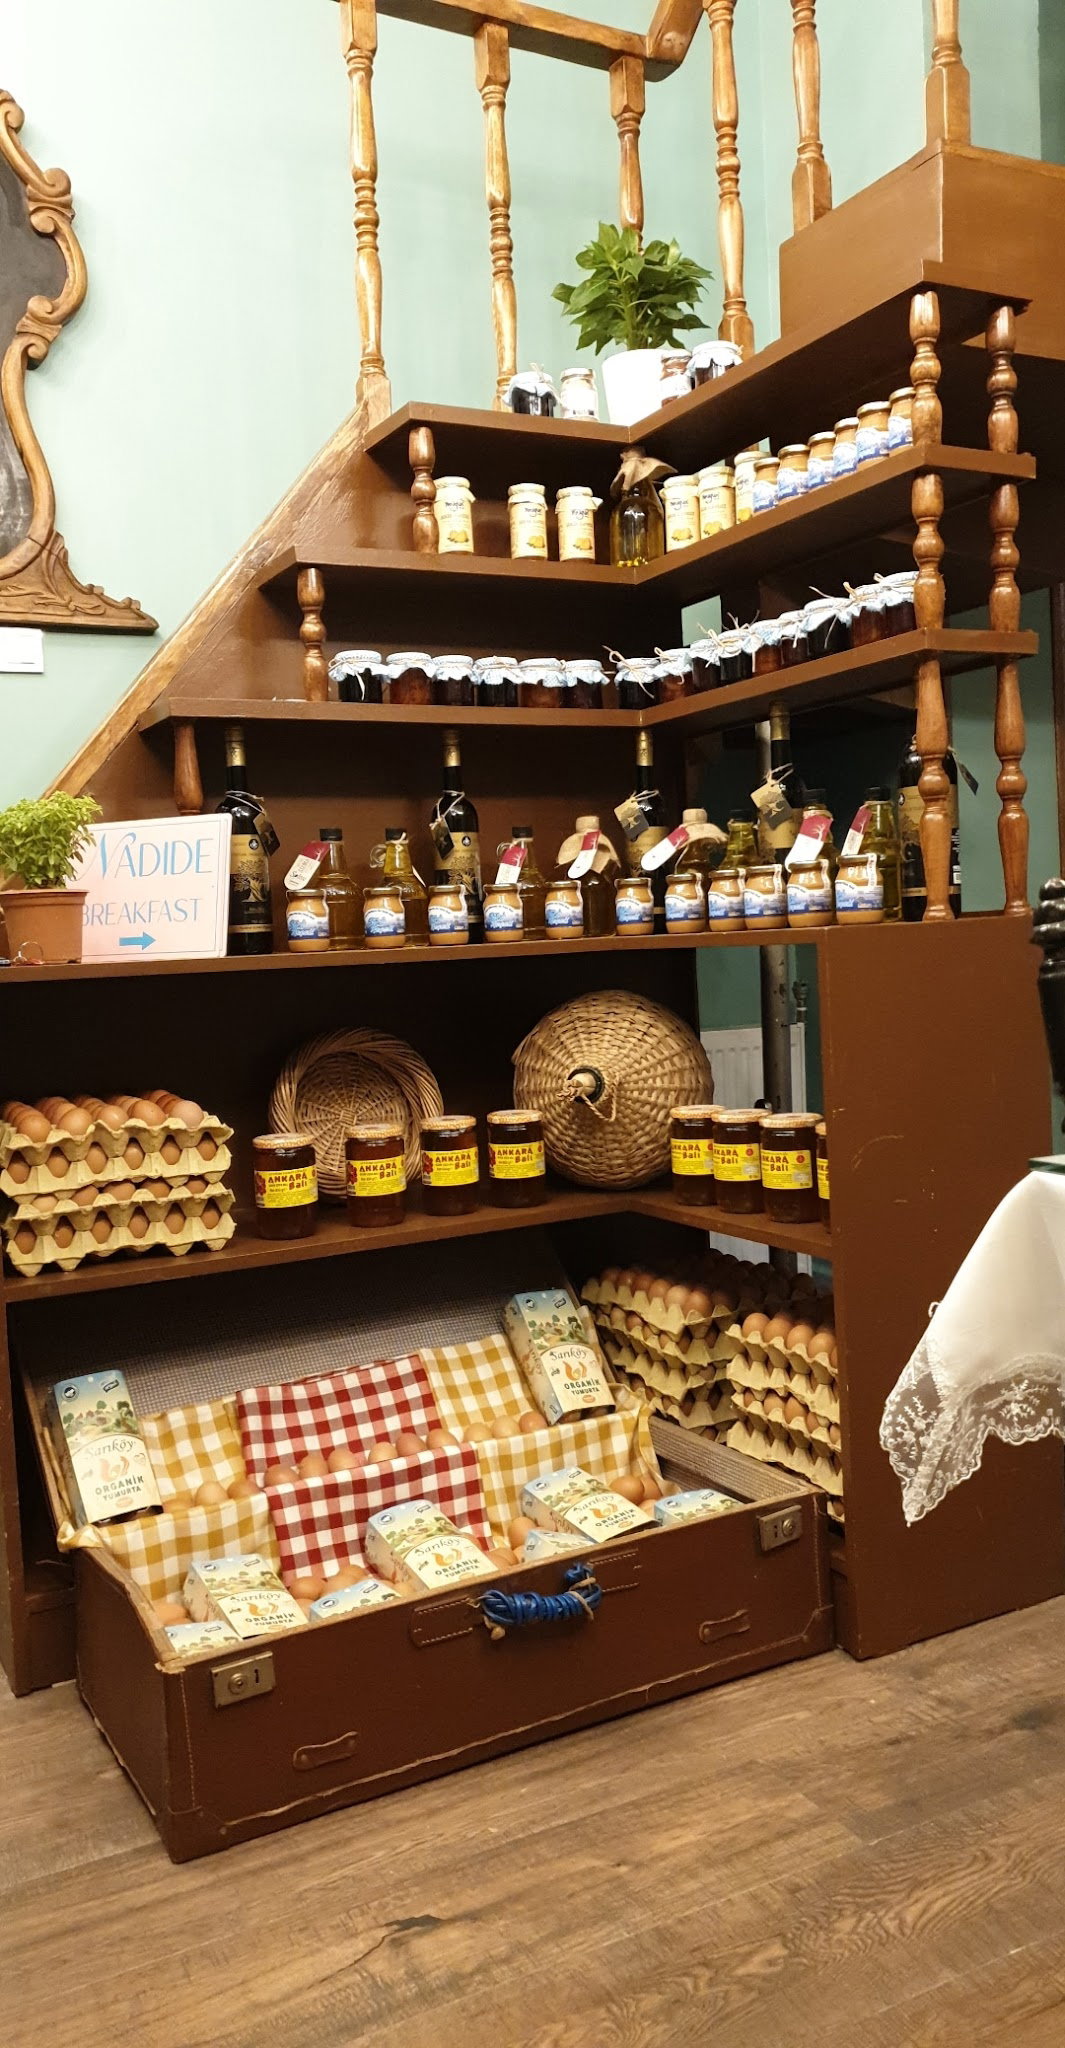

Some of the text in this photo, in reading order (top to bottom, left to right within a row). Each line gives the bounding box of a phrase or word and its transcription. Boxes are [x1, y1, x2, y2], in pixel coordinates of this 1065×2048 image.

[83, 898, 202, 926] BREAKFAST
[497, 1148, 533, 1156] ANKARA
[435, 1153, 471, 1163] ANKARA
[359, 1163, 397, 1172] ANKARA
[268, 1173, 307, 1184] ANKARA
[95, 1475, 144, 1495] ORGANİK
